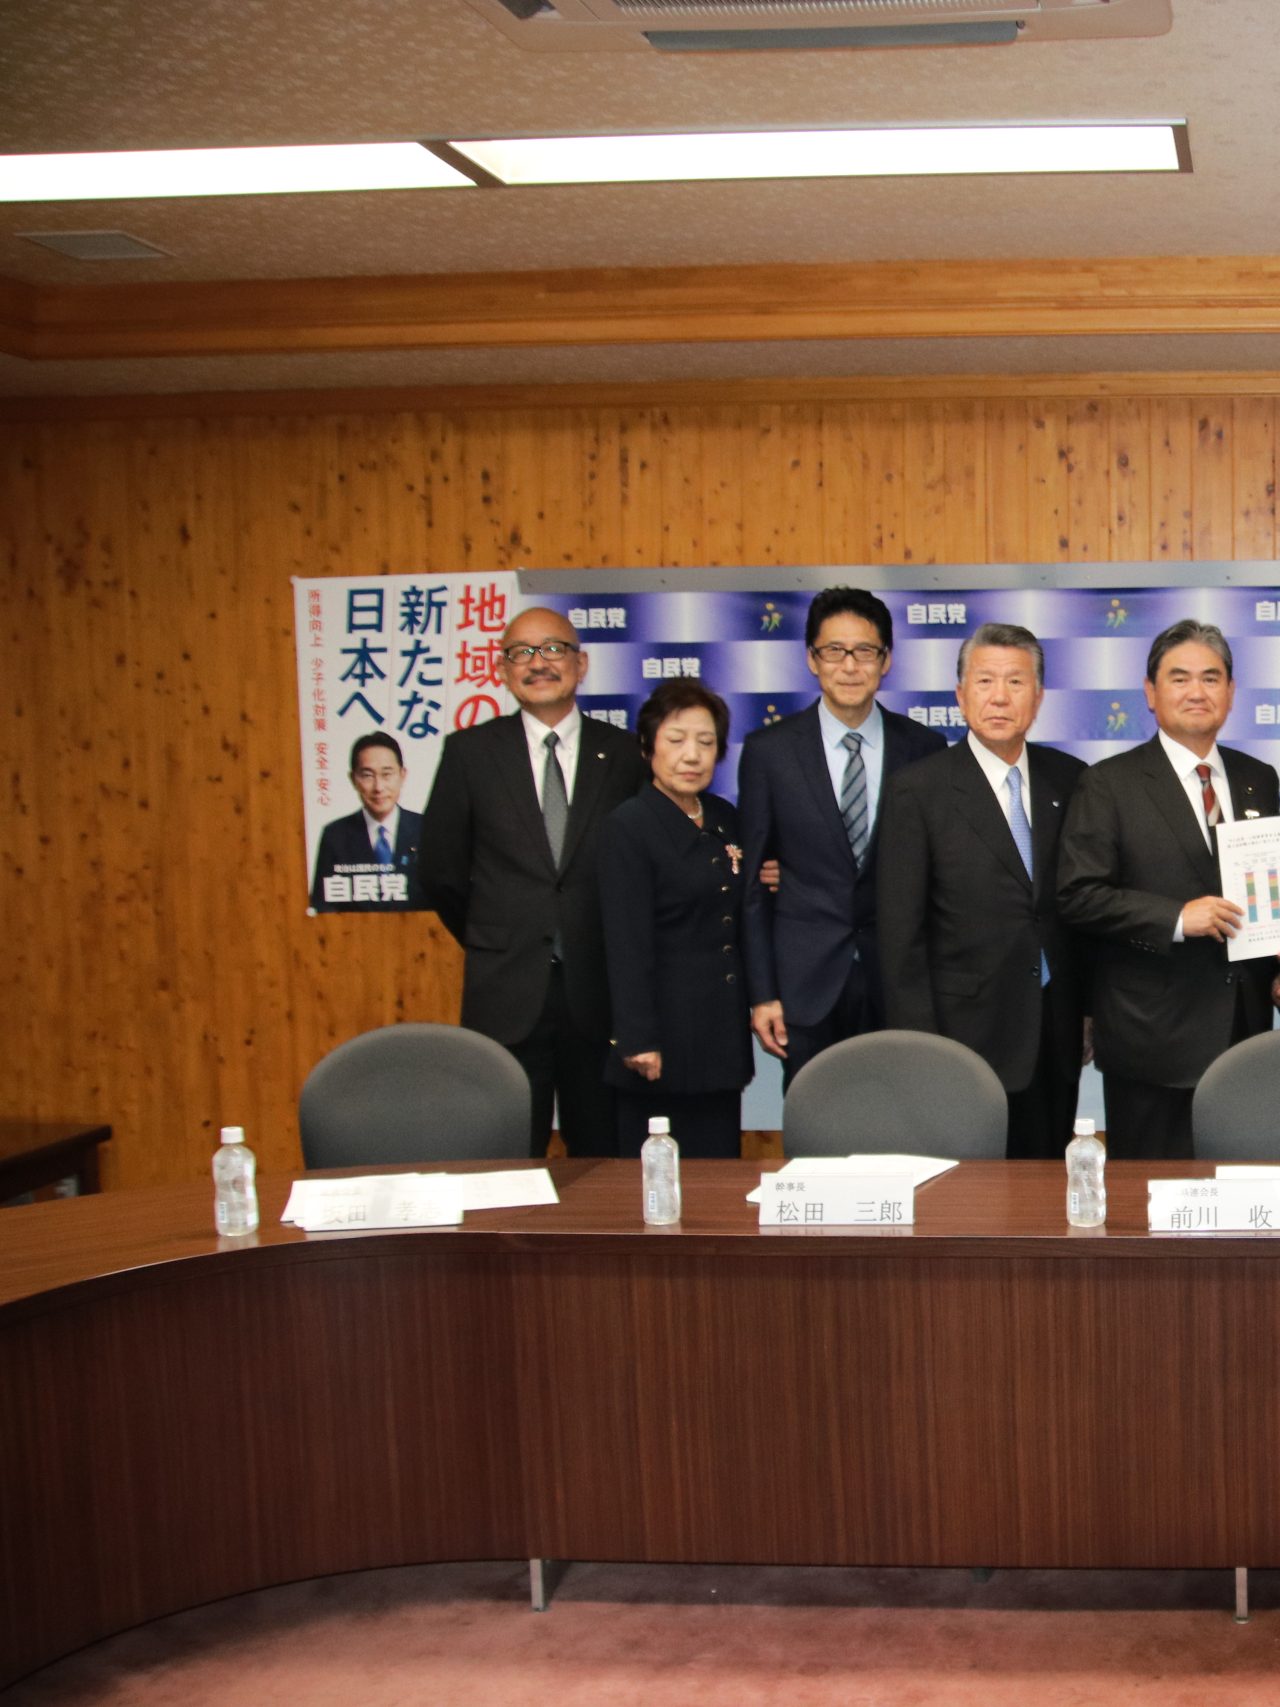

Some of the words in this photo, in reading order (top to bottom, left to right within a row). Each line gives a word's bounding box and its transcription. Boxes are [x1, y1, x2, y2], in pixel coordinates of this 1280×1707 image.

[307, 588, 325, 649] 所得向上
[568, 607, 627, 629] 自民党
[907, 603, 967, 624] 自民党
[336, 587, 388, 726] 日本へ
[396, 584, 448, 739] 新たな
[641, 657, 701, 679] 自民党
[311, 657, 328, 732] 少子化対策
[323, 873, 409, 902] 自民党
[775, 1181, 807, 1193] 幹事長
[775, 1199, 825, 1224] 松田
[853, 1199, 905, 1223] 三郎
[1169, 1205, 1219, 1229] 前川
